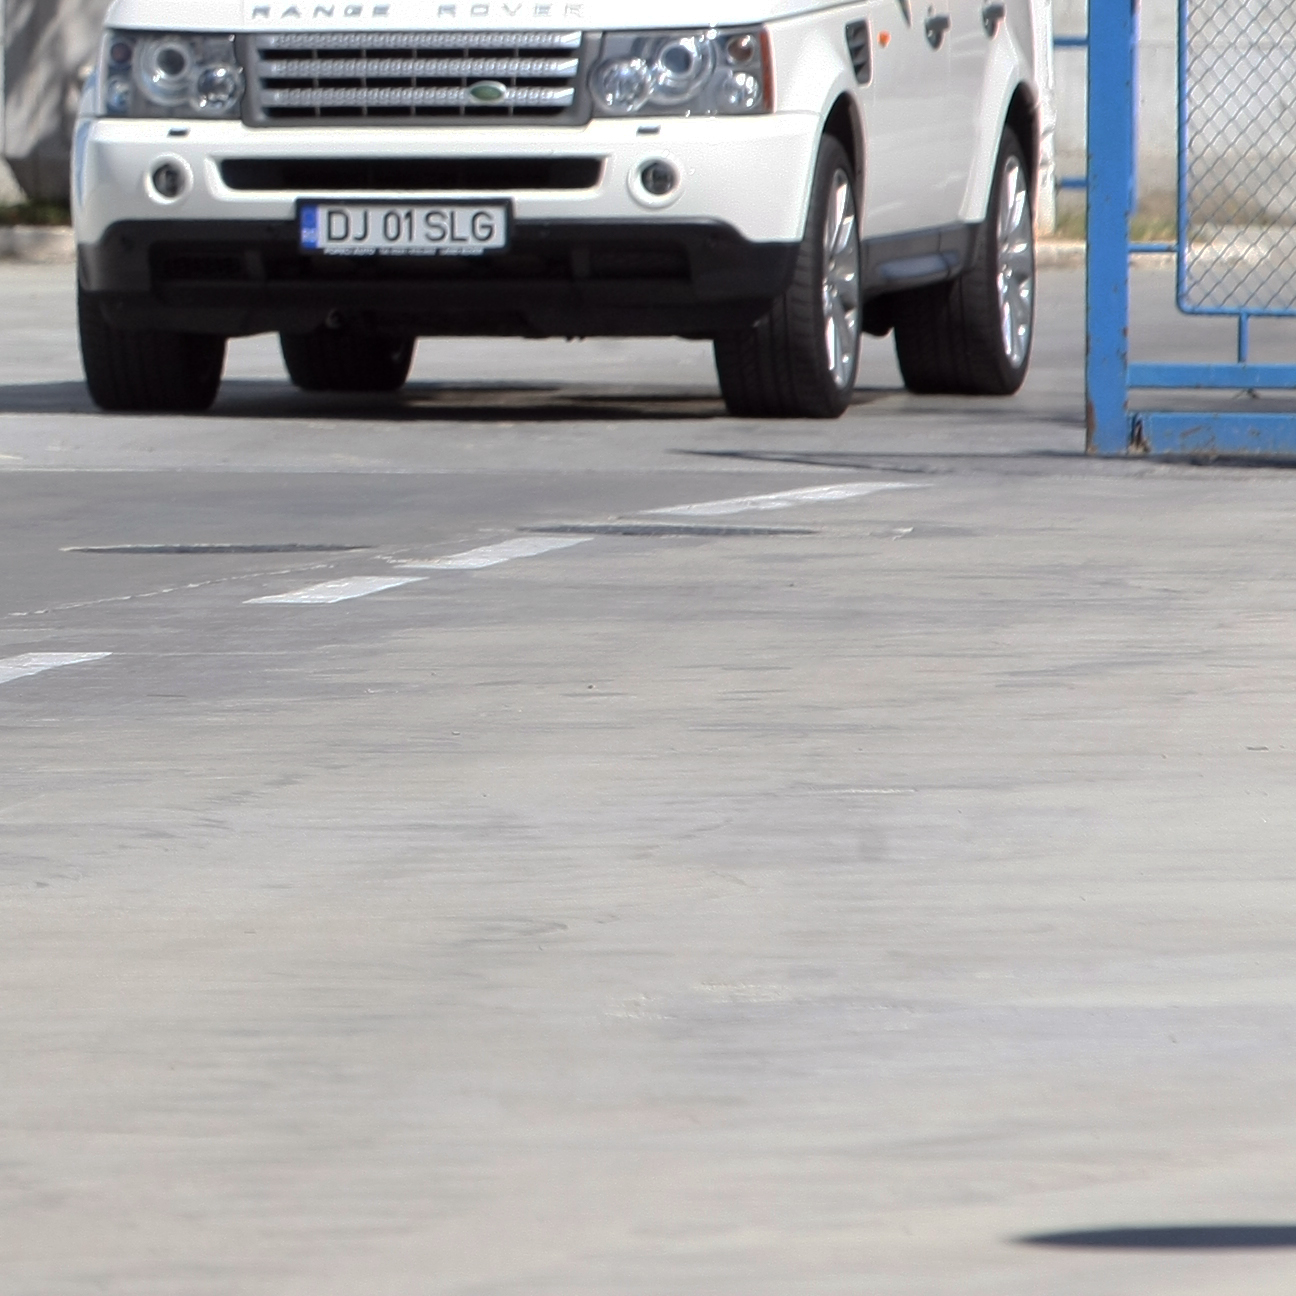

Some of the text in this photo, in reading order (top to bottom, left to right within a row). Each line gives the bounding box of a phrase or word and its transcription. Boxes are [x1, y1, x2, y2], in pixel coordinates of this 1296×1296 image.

[251, 3, 584, 20] RANGE ROVER
[327, 210, 369, 242] DJ
